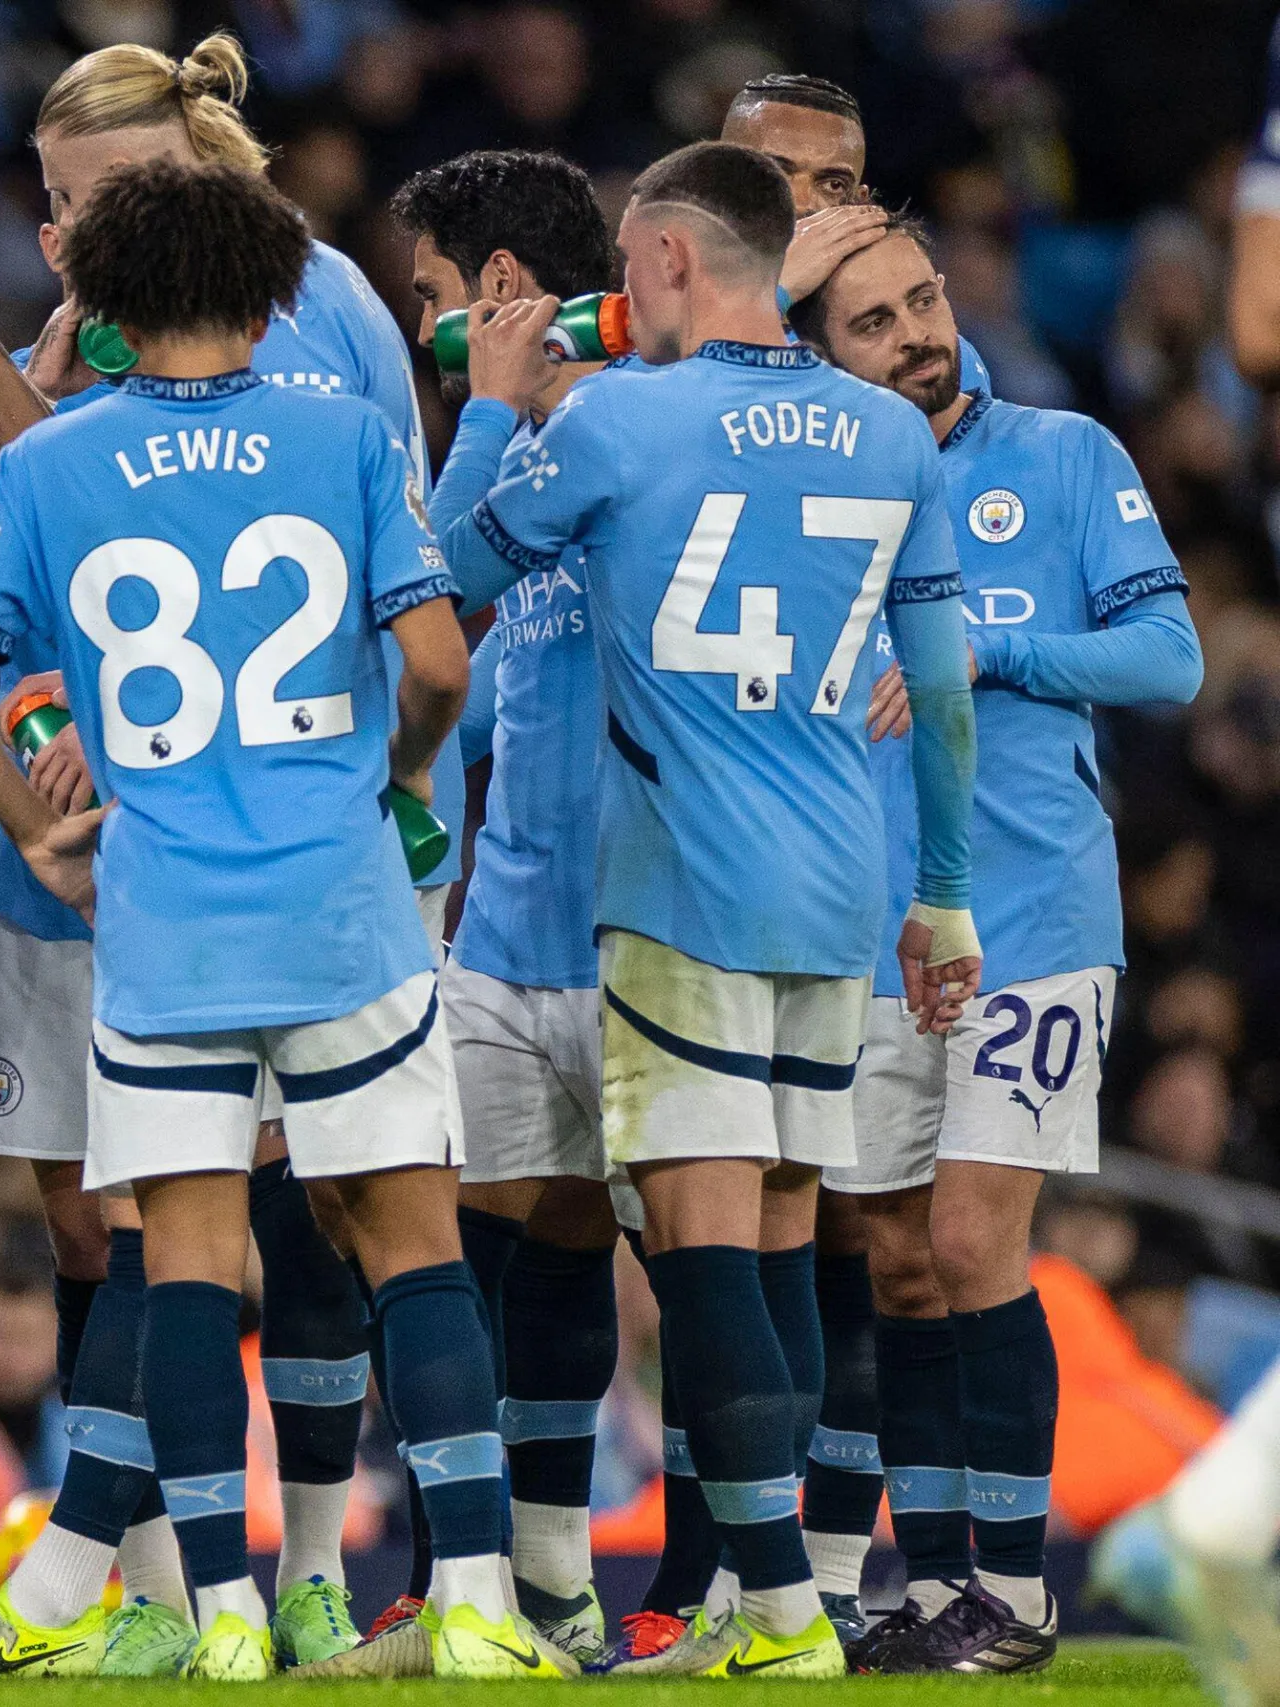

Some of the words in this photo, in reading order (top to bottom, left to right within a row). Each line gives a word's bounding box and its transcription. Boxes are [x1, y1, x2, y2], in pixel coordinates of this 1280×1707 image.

[766, 350, 798, 368] CITY
[174, 380, 210, 398] CITY
[720, 401, 861, 459] FODEN
[115, 427, 271, 490] LEWIS
[972, 490, 1021, 512] MANCHESTER
[987, 534, 1007, 542] CITY
[651, 491, 915, 716] 47
[68, 513, 355, 769] 82
[505, 609, 585, 649] IRWAYS
[972, 993, 1083, 1092] 20
[824, 1444, 880, 1460] CITY
